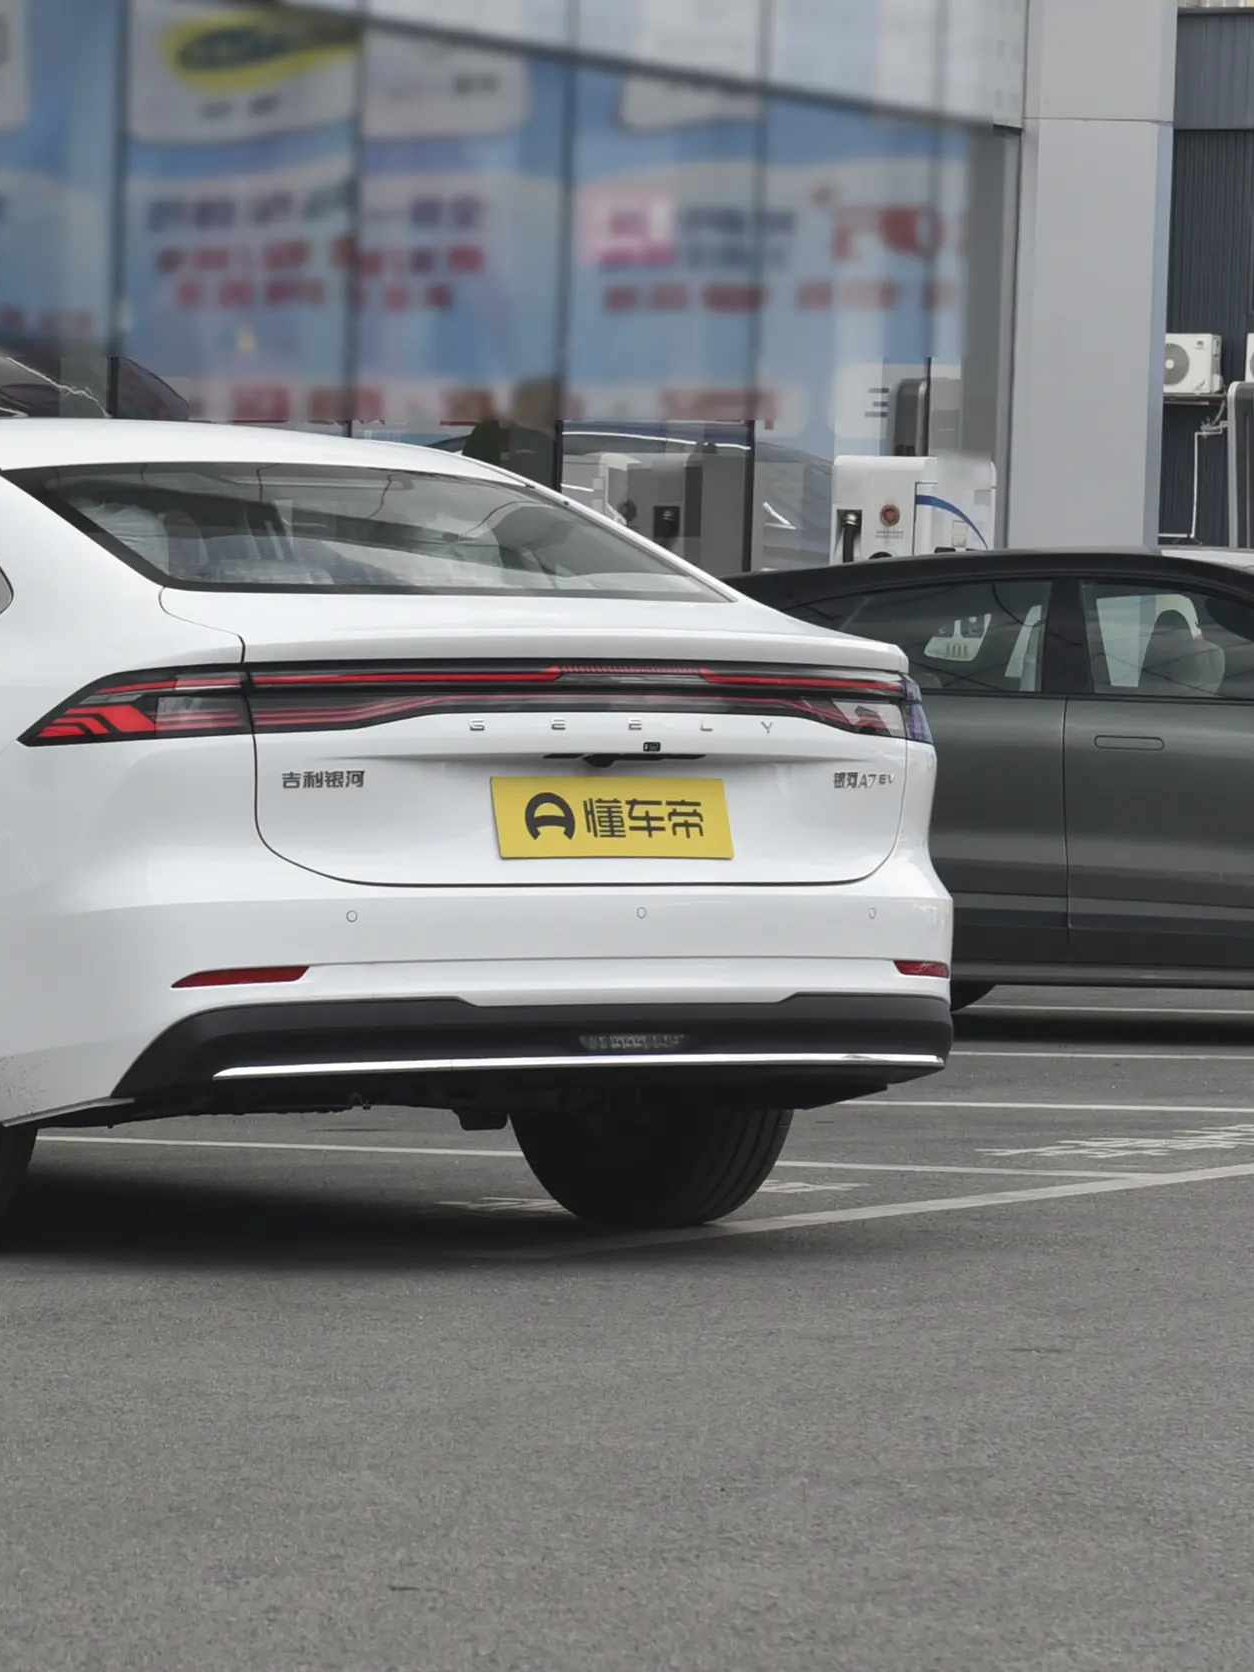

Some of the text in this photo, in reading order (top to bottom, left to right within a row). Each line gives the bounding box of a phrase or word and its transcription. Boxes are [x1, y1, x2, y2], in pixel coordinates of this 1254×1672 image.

[469, 718, 774, 733] GEELY
[281, 770, 365, 789] 吉利银河
[582, 797, 705, 839] 懂车帝
